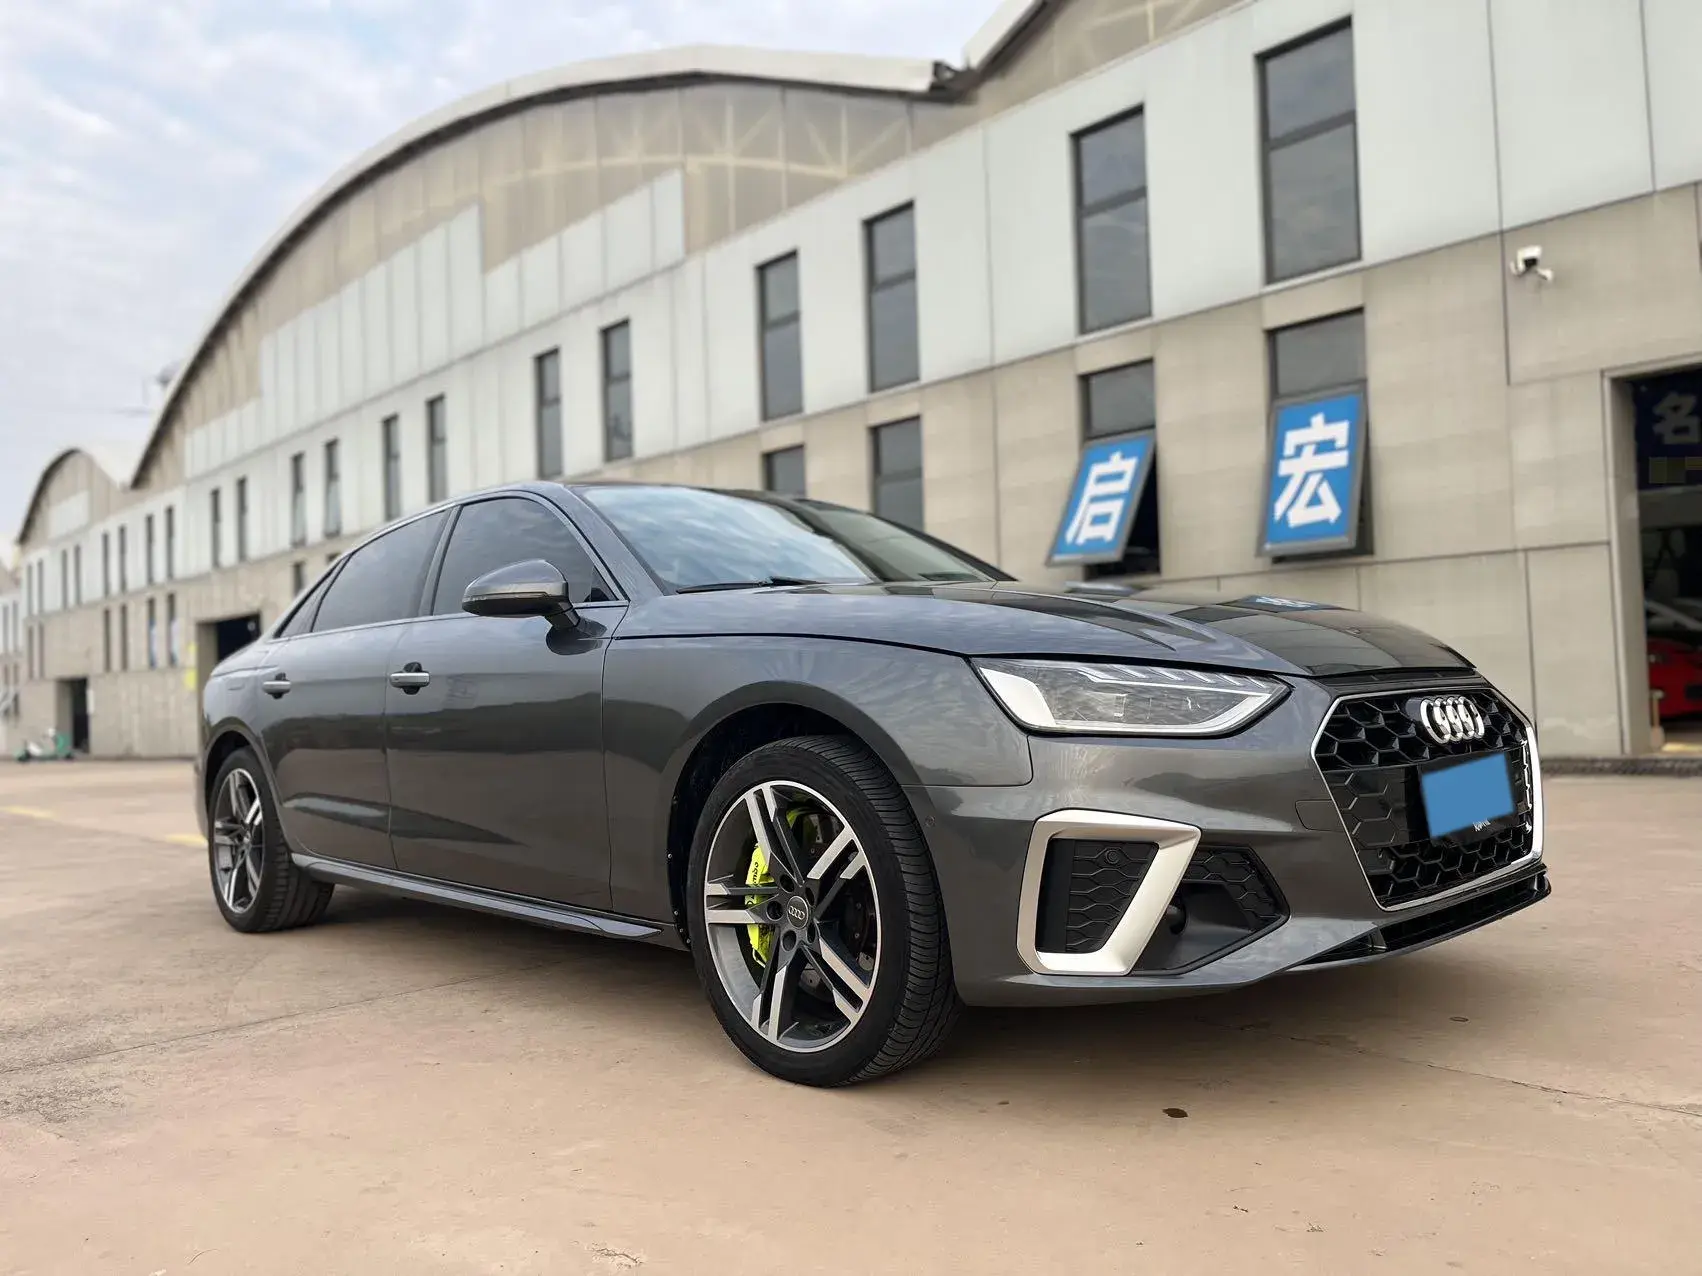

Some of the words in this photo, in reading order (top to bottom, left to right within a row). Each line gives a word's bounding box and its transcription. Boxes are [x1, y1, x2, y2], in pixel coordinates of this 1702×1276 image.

[1652, 391, 1699, 444] 名
[1065, 451, 1138, 545] 启
[1274, 412, 1349, 528] 宏
